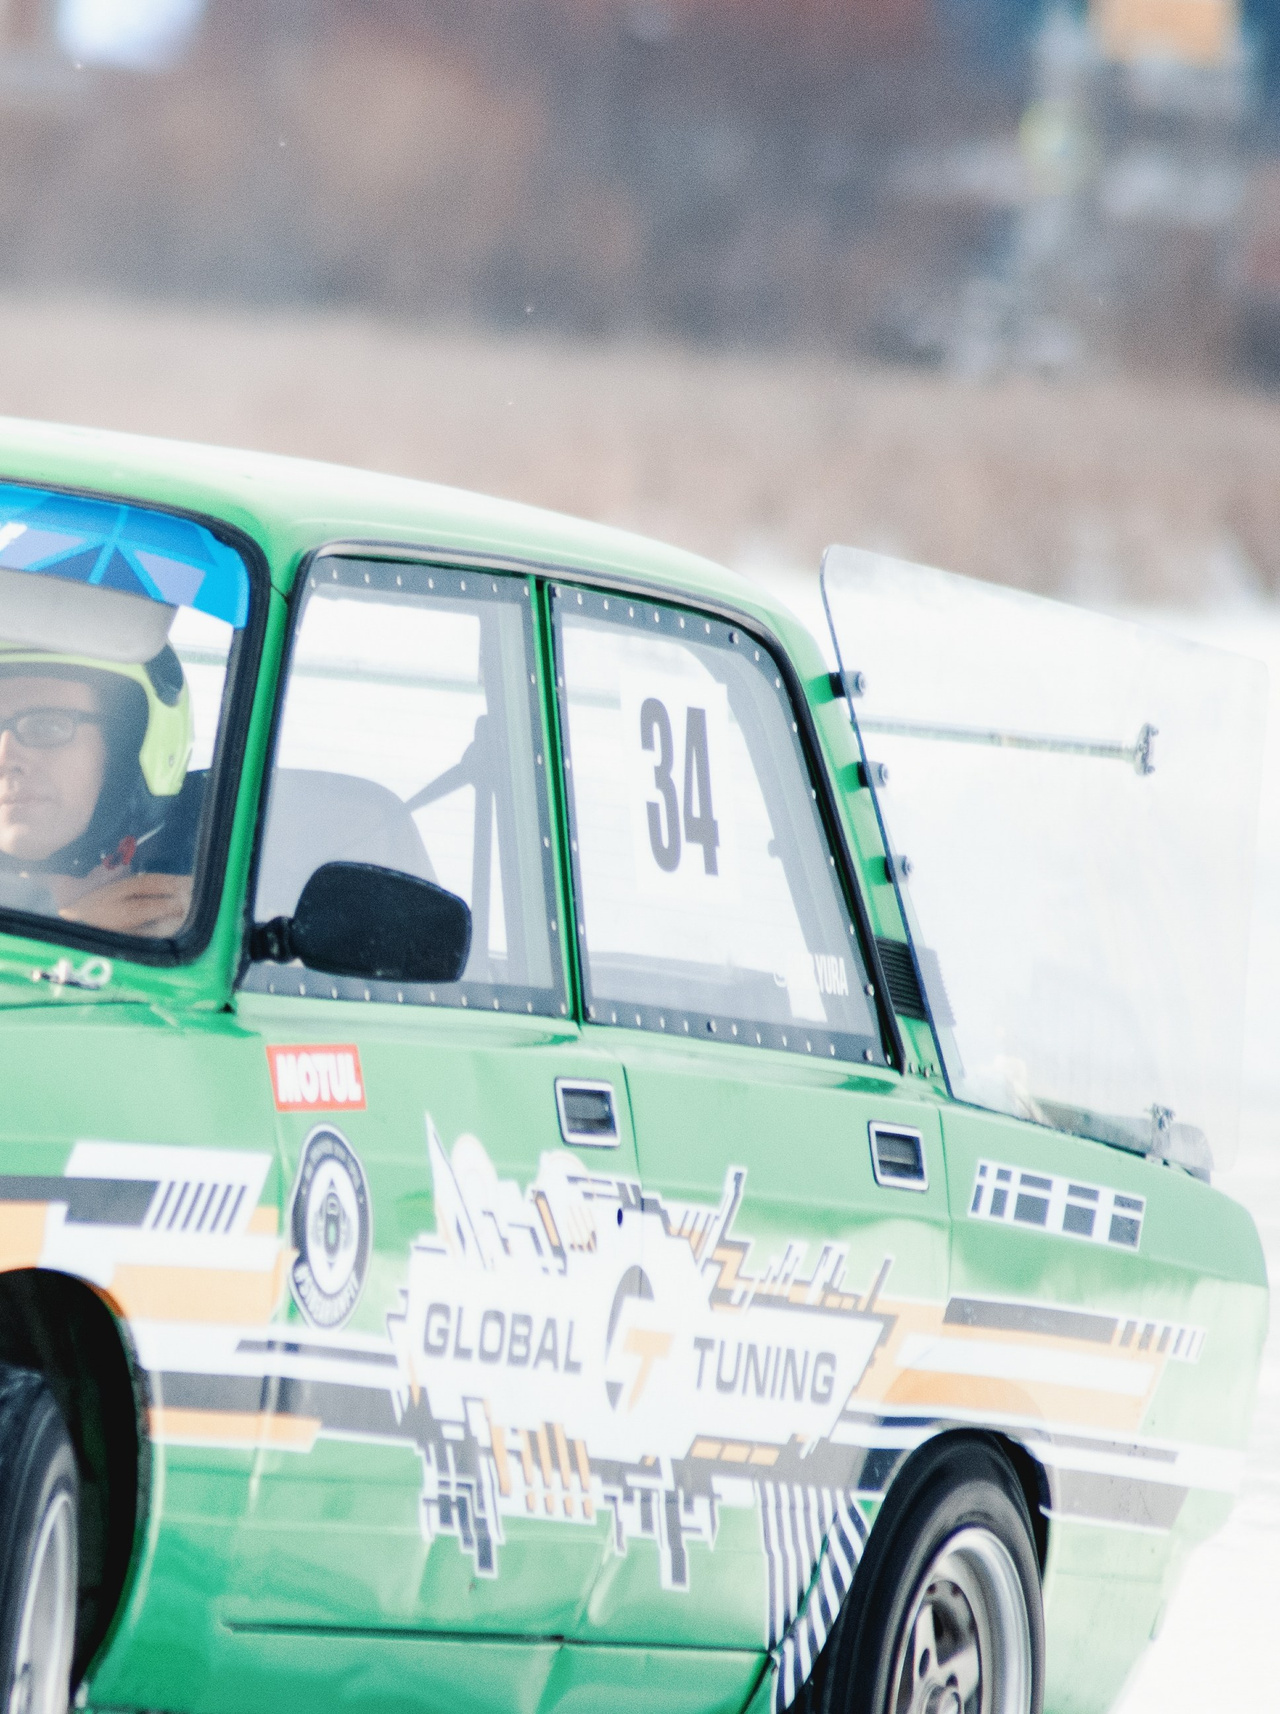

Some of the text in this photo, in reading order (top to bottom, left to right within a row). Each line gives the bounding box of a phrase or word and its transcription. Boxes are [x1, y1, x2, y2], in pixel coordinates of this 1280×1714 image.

[640, 697, 720, 876] 34
[276, 1053, 362, 1103] MOTUL
[423, 1302, 837, 1405] GLOBAL TUNING
